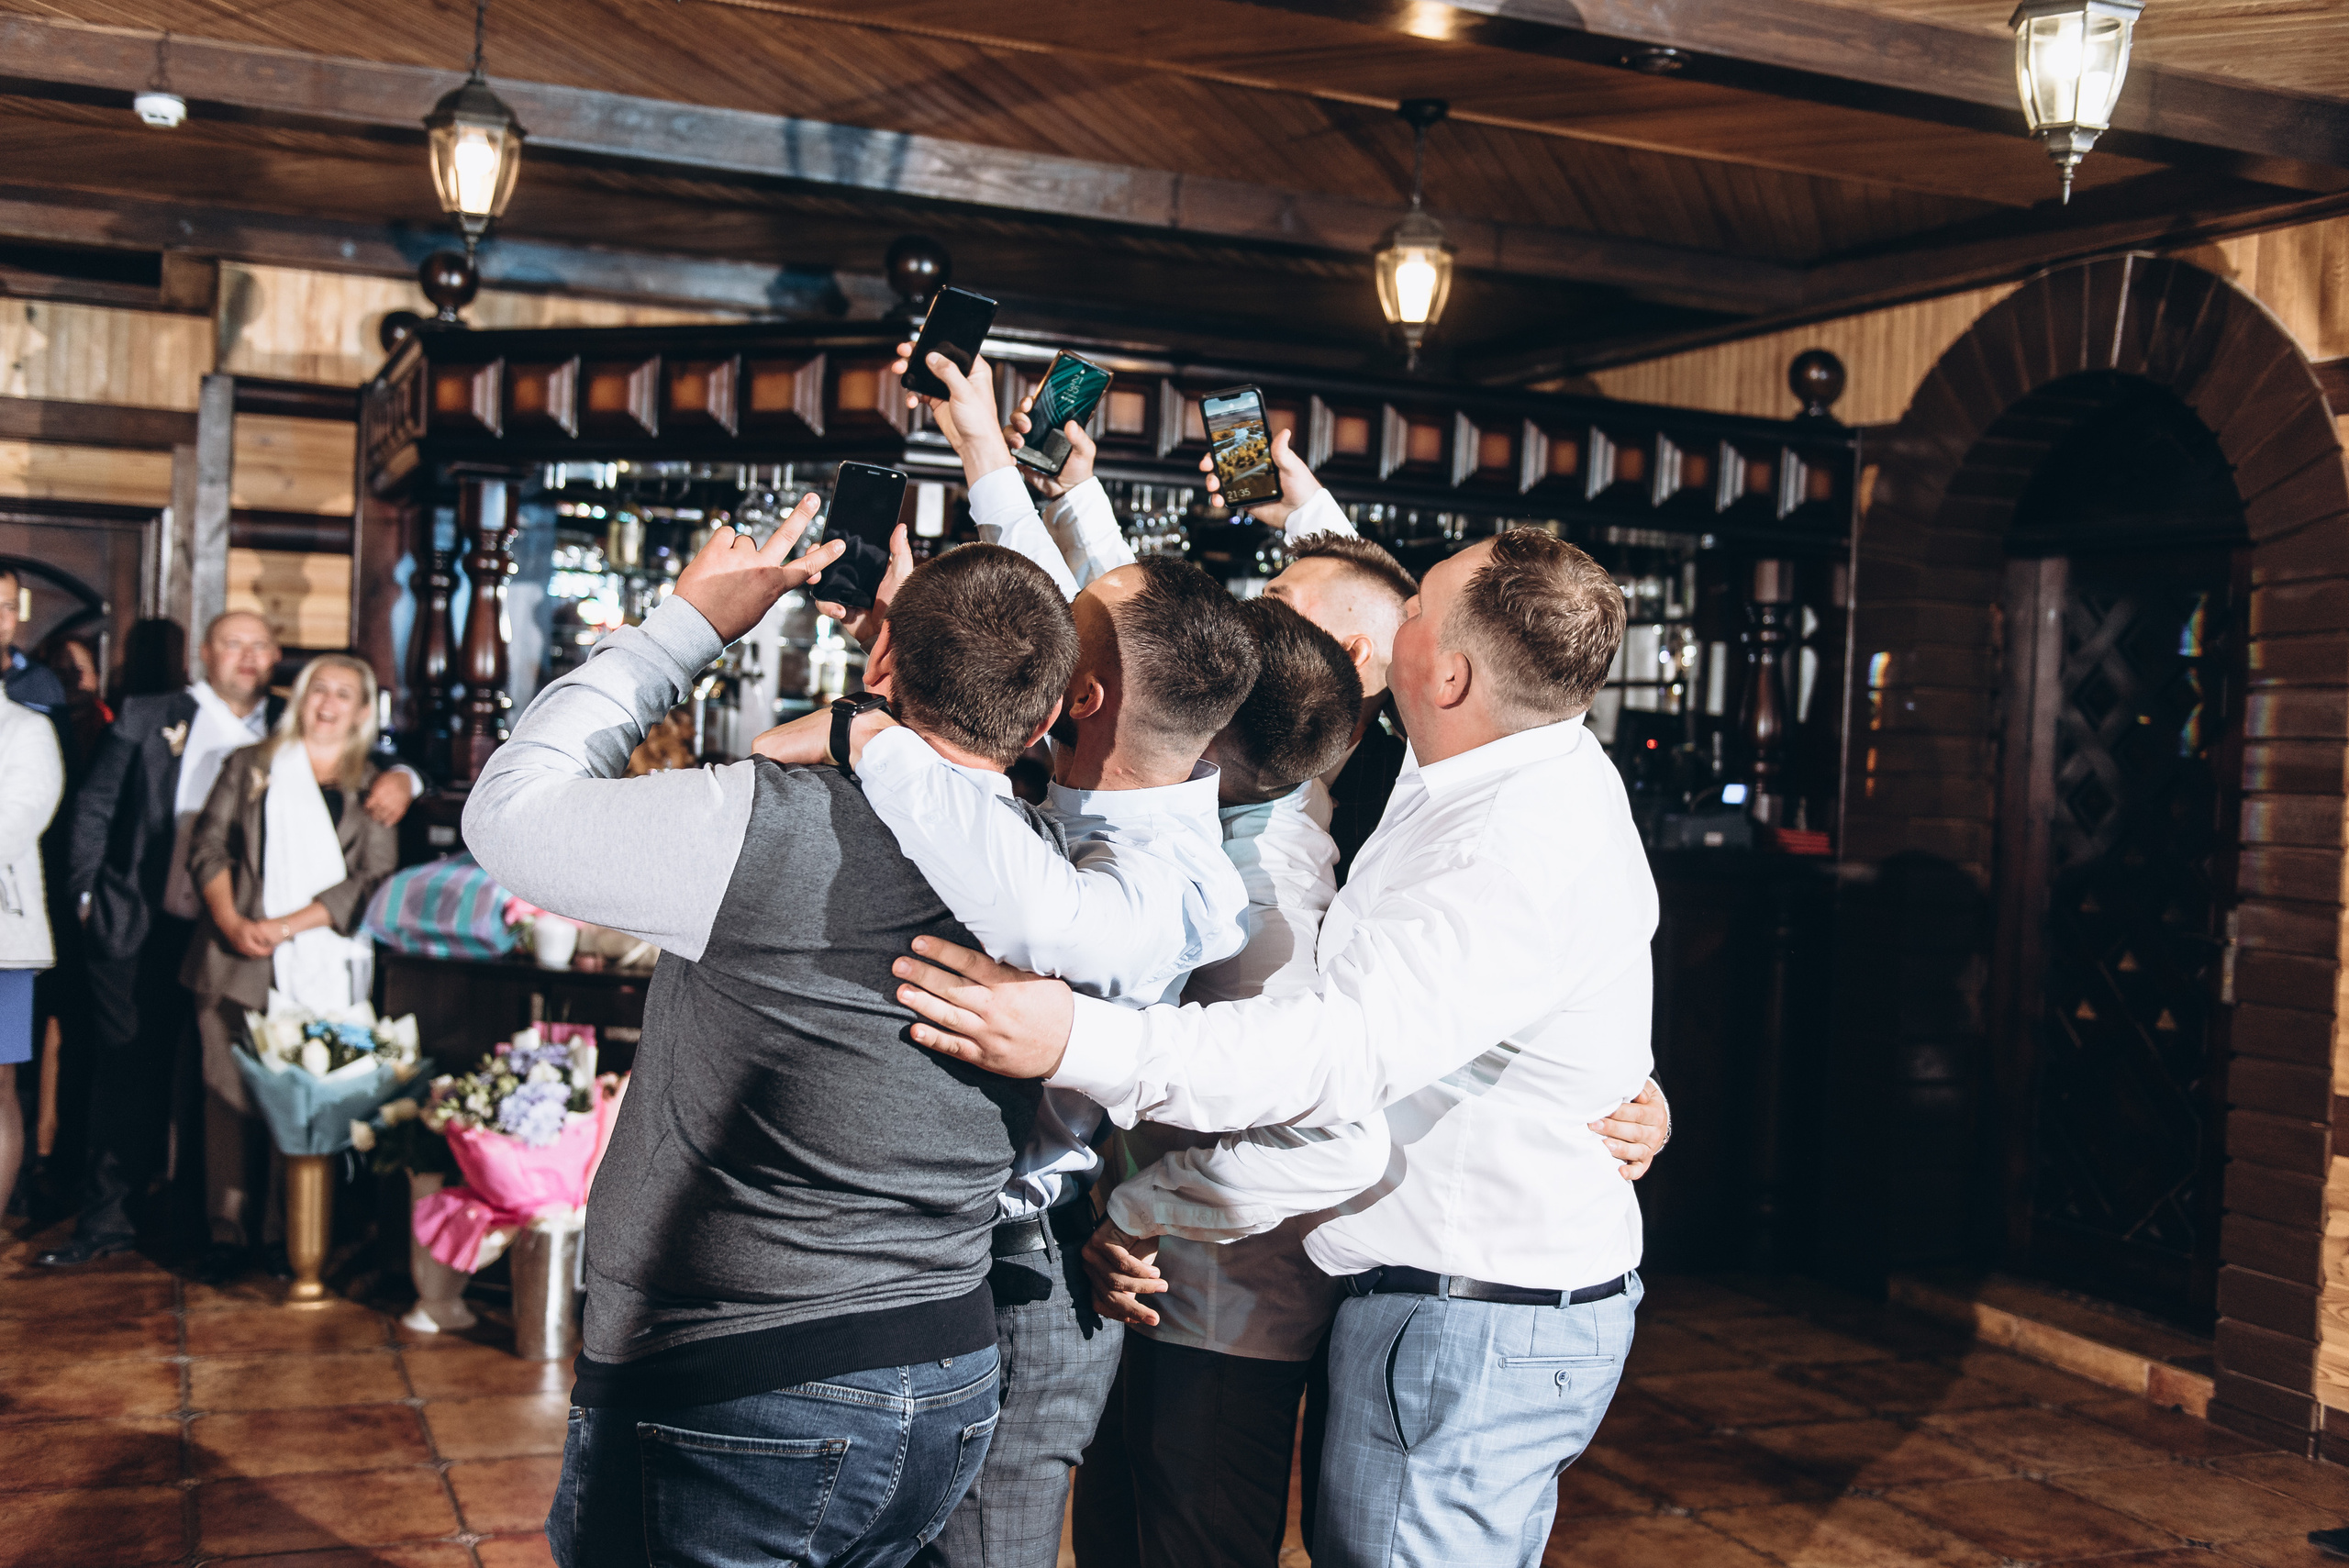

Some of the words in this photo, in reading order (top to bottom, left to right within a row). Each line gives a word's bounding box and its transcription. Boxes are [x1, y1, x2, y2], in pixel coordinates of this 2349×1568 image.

[1071, 374, 1084, 384] 21
[1067, 383, 1080, 394] 35
[1227, 487, 1251, 499] 21:35
